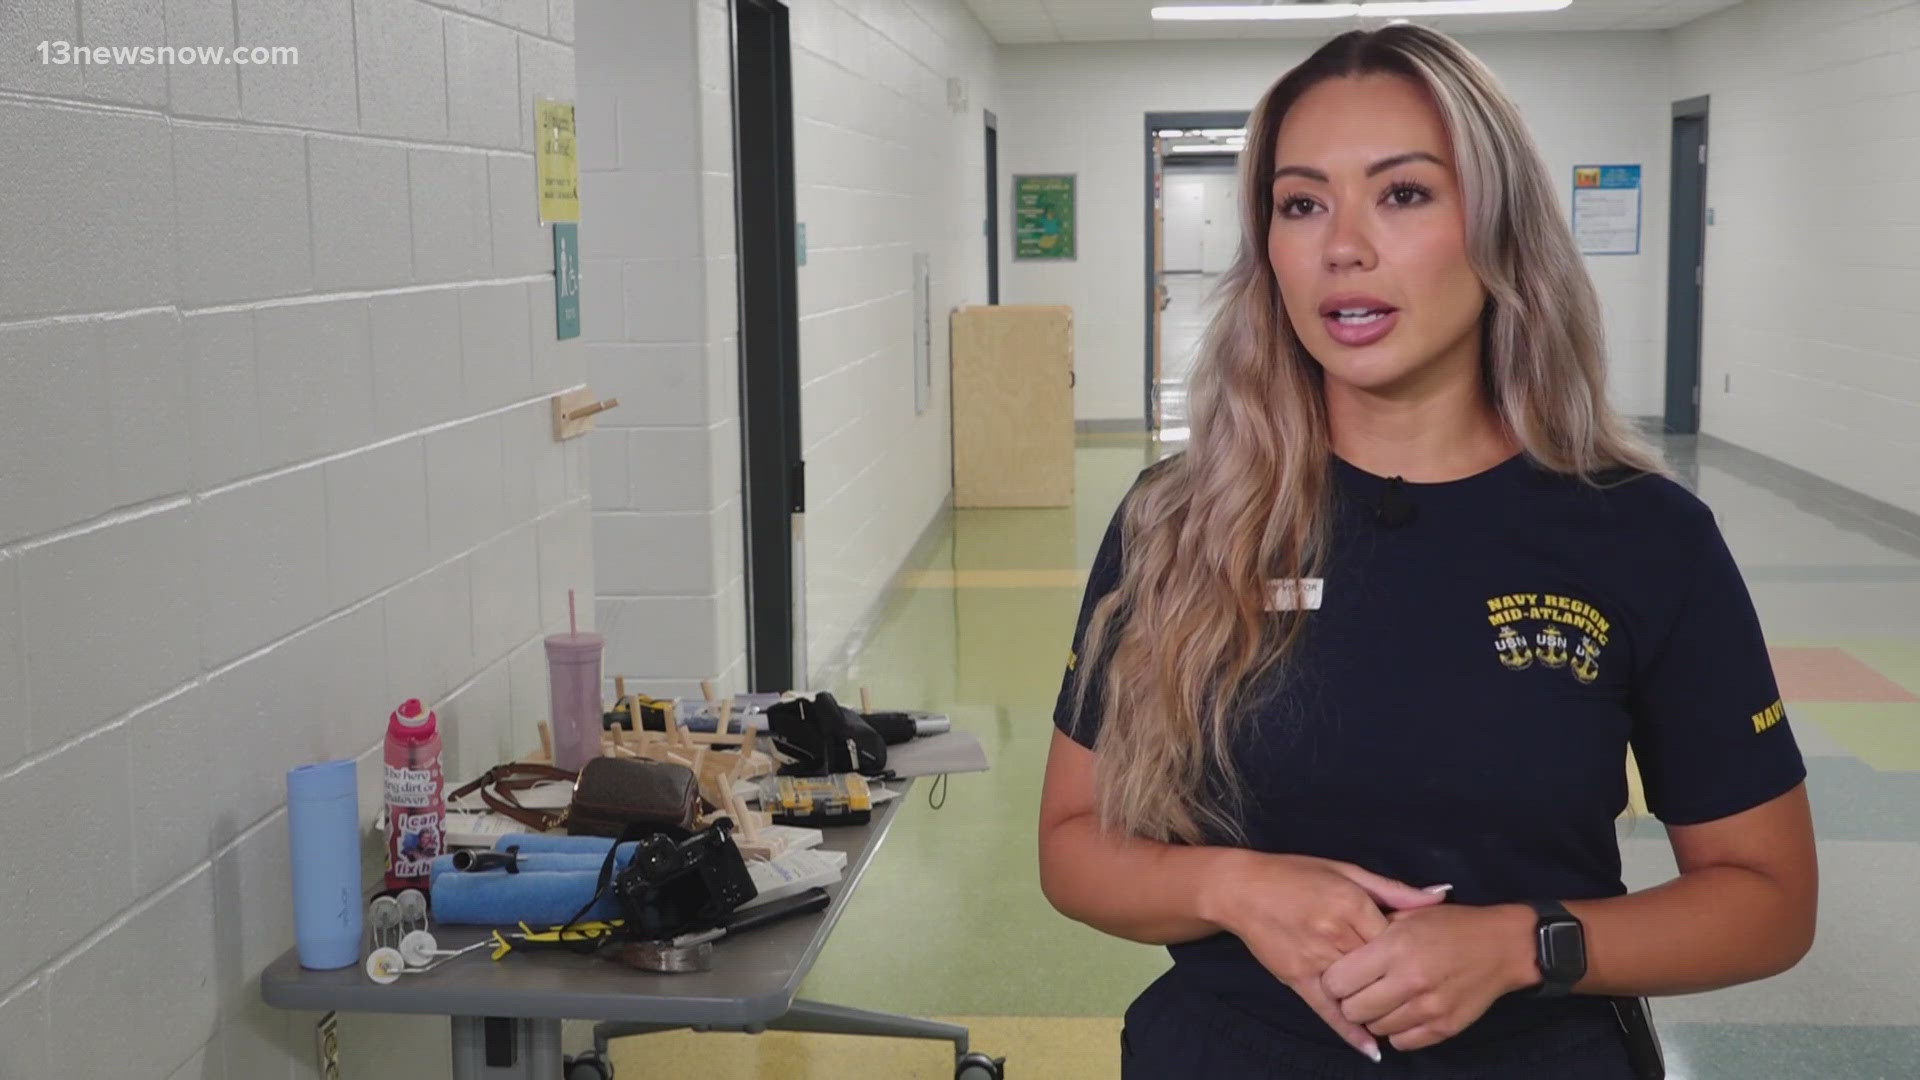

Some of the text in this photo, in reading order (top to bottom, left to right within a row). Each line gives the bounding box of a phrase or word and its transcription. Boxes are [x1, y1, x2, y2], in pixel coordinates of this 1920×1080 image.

[1487, 593, 1610, 632] NAVY REGION
[1488, 606, 1609, 646] MID-ATLANTIC
[1494, 635, 1527, 652] USN
[1536, 633, 1567, 648] USN
[403, 770, 429, 780] here
[401, 781, 421, 792] dirt
[423, 783, 436, 792] or
[411, 815, 436, 826] can
[397, 862, 415, 875] fix
